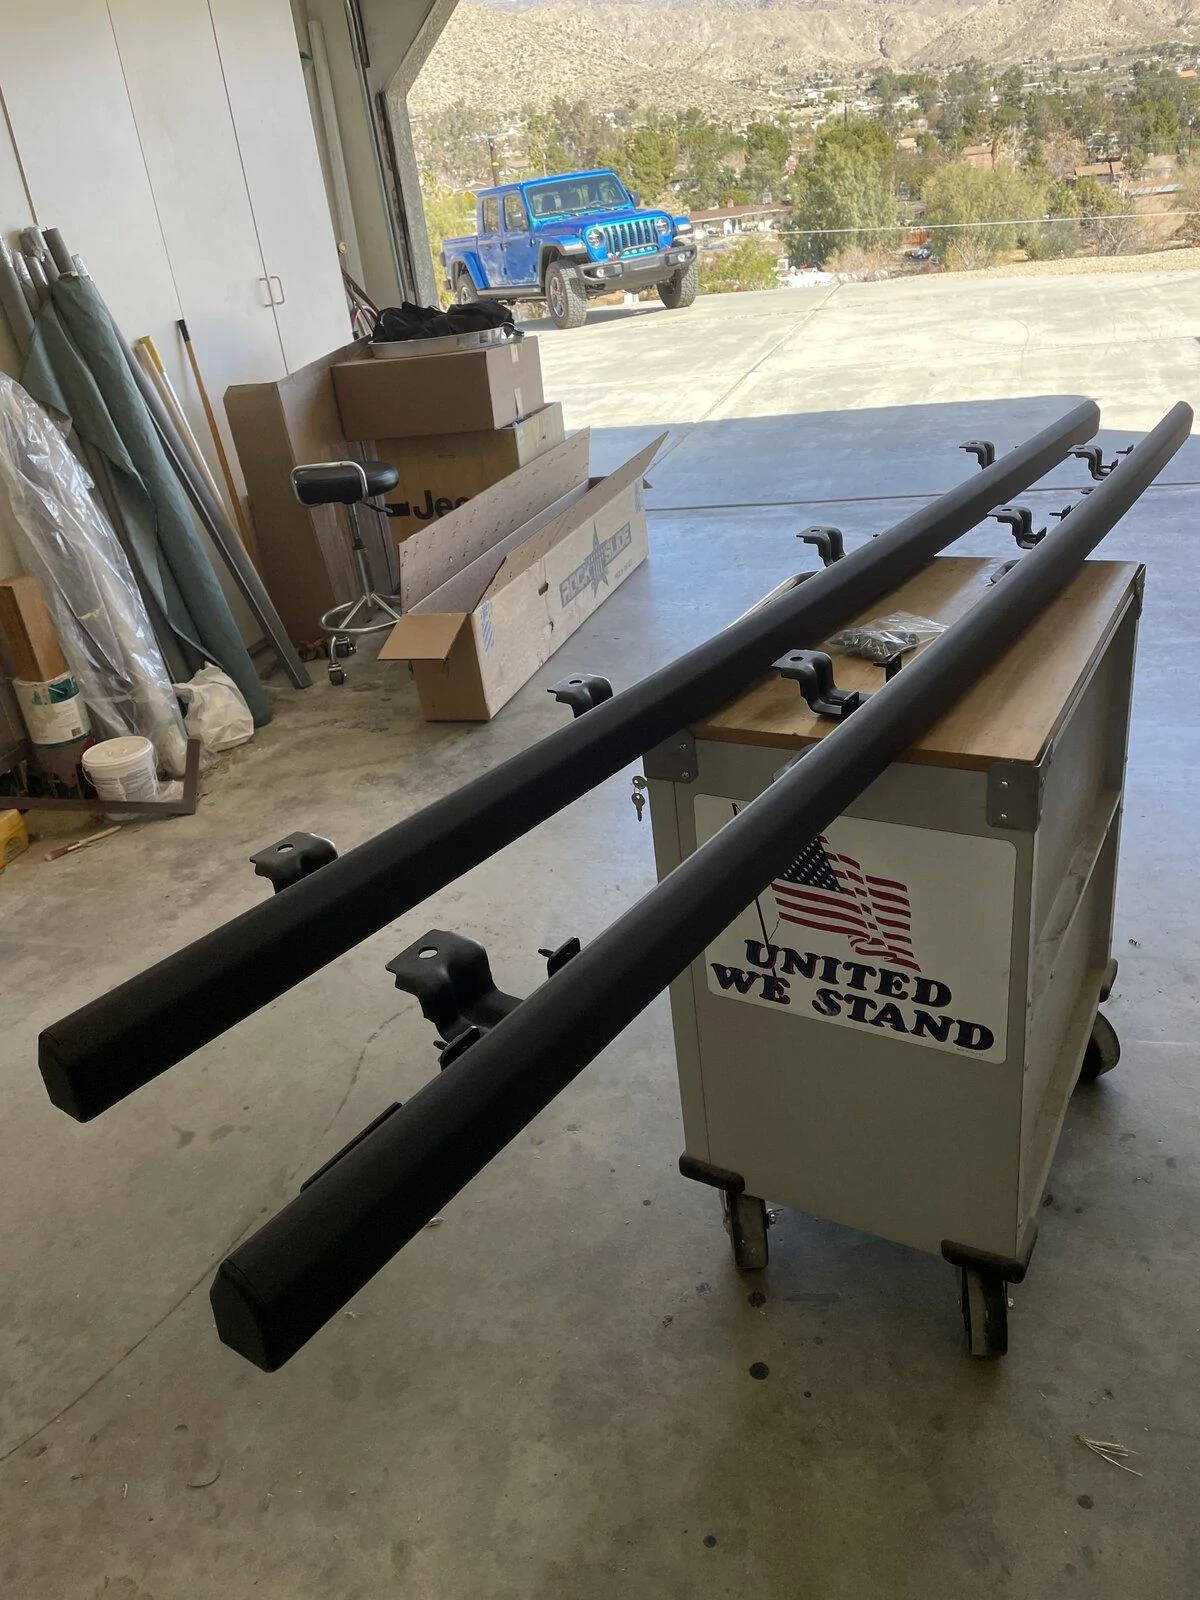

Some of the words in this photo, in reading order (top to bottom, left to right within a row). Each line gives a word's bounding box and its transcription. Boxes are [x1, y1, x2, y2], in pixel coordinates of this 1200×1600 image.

[710, 963, 791, 1005] WE
[812, 988, 995, 1051] STAND
[744, 939, 952, 1008] UNITED
